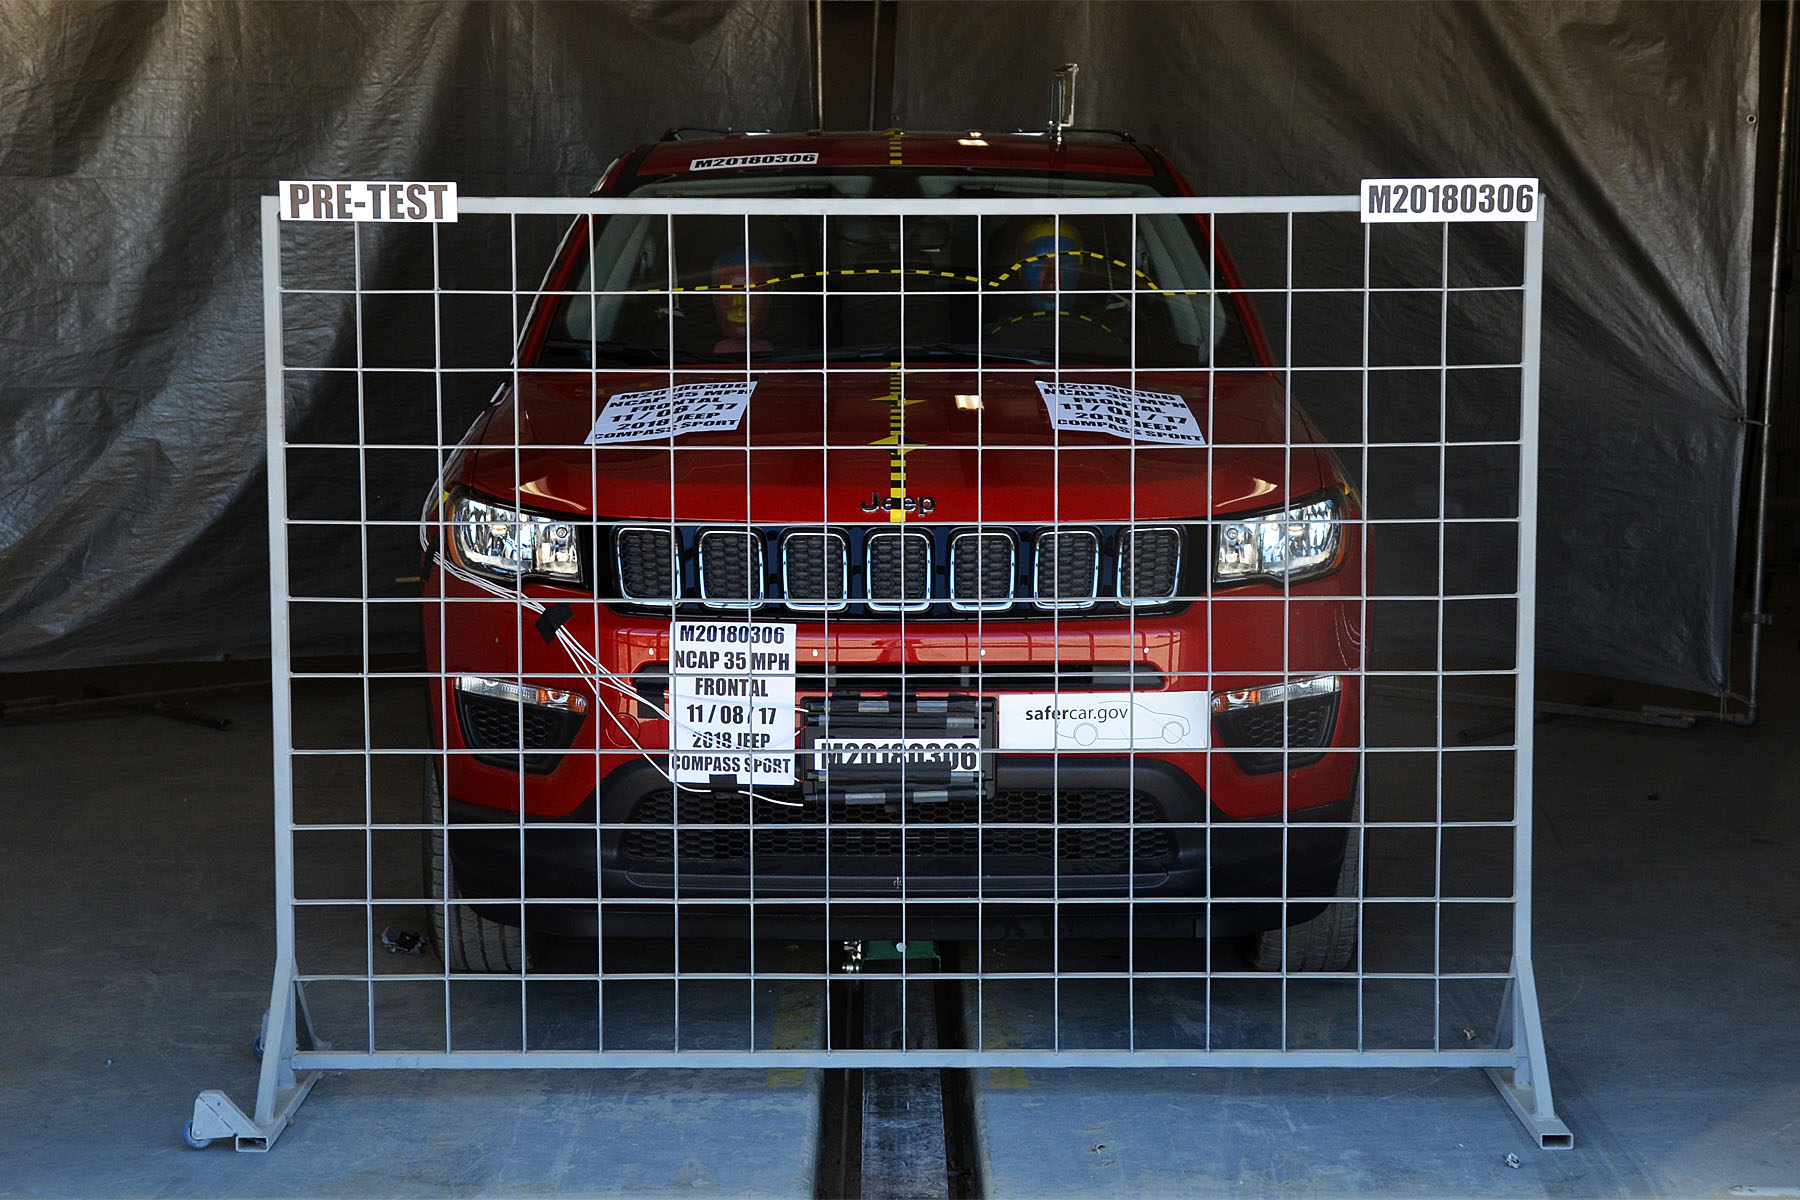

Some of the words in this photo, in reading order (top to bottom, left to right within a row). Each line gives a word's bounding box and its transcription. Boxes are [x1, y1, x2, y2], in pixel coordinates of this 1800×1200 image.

[694, 154, 816, 168] M20180306
[289, 183, 448, 220] PRE-TEST
[1368, 184, 1534, 214] M20180306
[608, 396, 666, 408] NCAP
[672, 392, 698, 400] 35
[703, 388, 752, 396] MPH
[620, 383, 748, 400] M20180306
[1044, 388, 1101, 398] NCAP
[1139, 398, 1187, 408] MPH
[630, 397, 722, 412] FRONTAL
[1073, 397, 1166, 414] FRONTAL
[592, 424, 677, 440] COMPASS
[680, 419, 739, 429] SPORT
[616, 418, 670, 430] 2018
[674, 412, 721, 423] JEEP
[1057, 419, 1142, 436] COMPASS
[1146, 431, 1202, 442] SPORT
[1074, 412, 1128, 426] 2018
[1133, 420, 1178, 432] JEEP
[860, 492, 936, 518] Jeep
[680, 624, 785, 644] M20180306
[676, 650, 720, 669] NCAP
[724, 651, 746, 670] 35
[752, 652, 790, 671] MPH
[695, 678, 768, 698] FRONTAL
[1025, 705, 1128, 723] safercar.gov
[692, 732, 732, 748] 2018
[736, 732, 770, 750] JEEP
[672, 755, 741, 772] COMPASS
[744, 757, 791, 774] SPORT
[821, 742, 977, 770] M20180306
